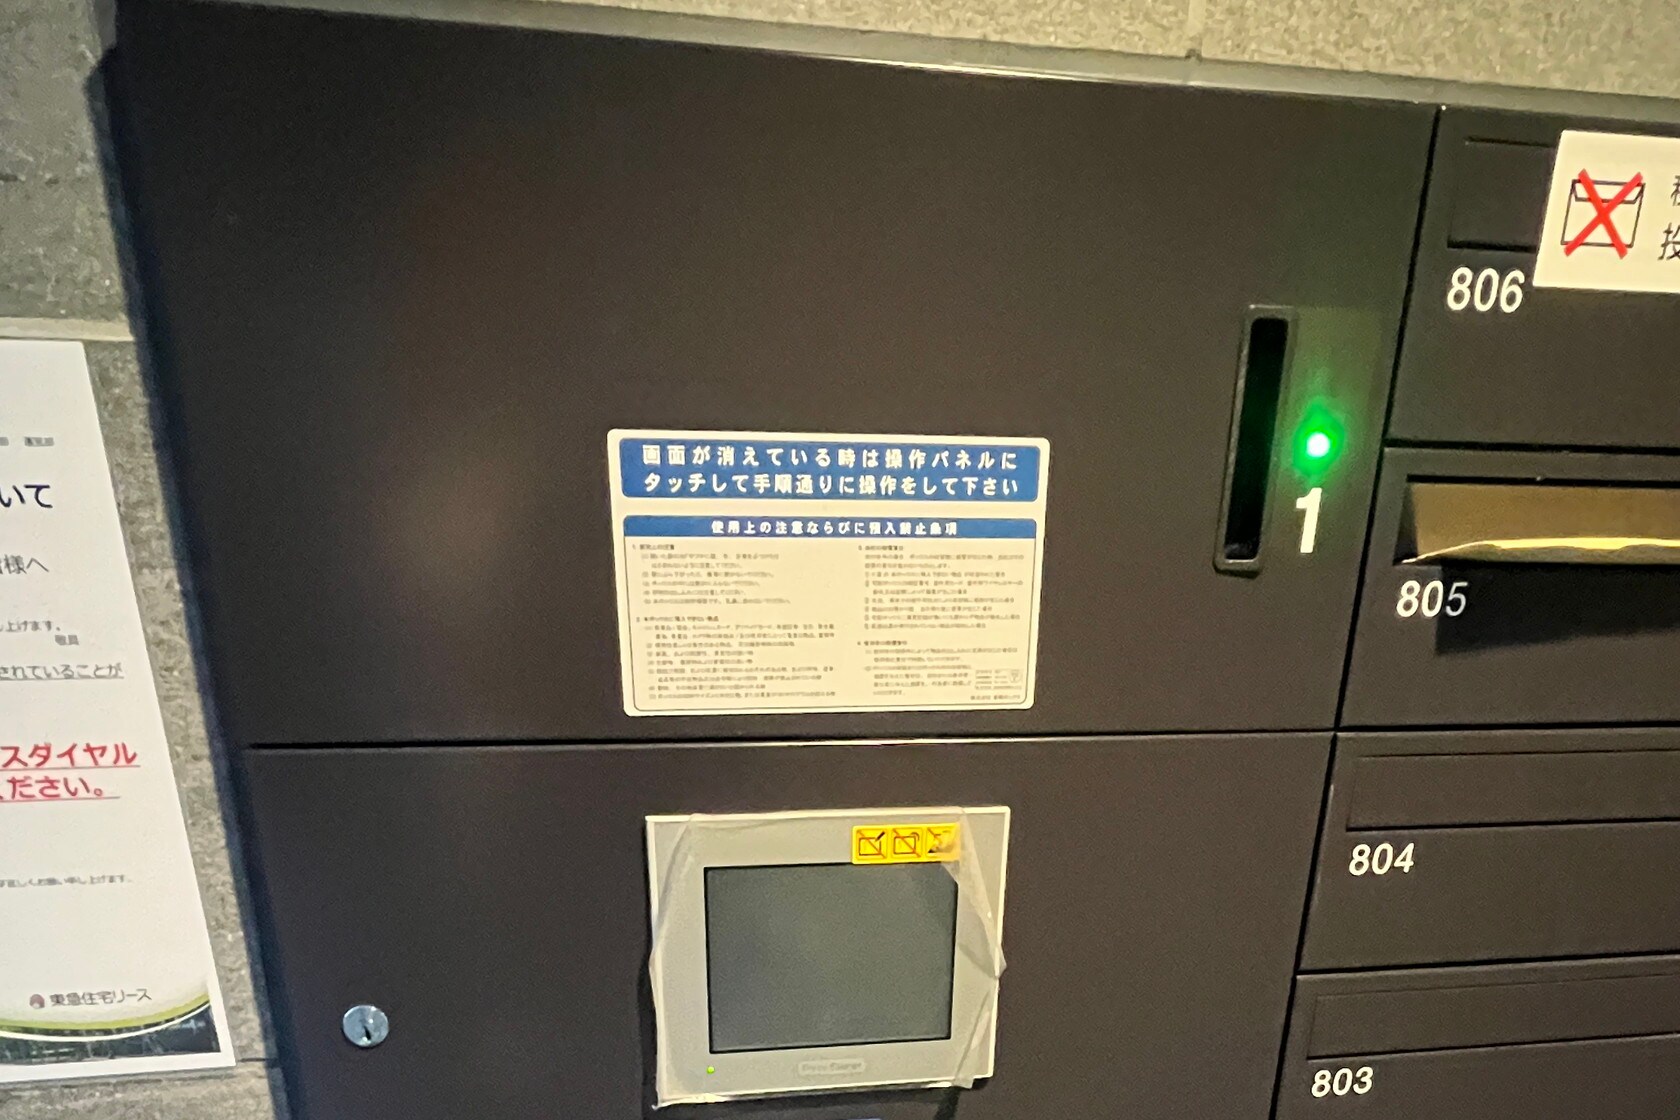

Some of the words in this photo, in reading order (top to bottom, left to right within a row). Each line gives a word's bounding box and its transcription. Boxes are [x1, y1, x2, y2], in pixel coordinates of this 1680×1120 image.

[1446, 266, 1524, 313] 806
[643, 444, 1017, 469] 画面が消えている時は操作パネルに
[644, 471, 1018, 494] タッチして手順通りに操作をして下さい
[1296, 488, 1322, 553] 1
[0, 554, 50, 575] 様へ
[1396, 580, 1468, 618] 805
[0, 620, 61, 633] 上げます。
[0, 742, 137, 768] スダイヤル
[0, 776, 103, 799] ださい。
[1349, 843, 1414, 875] 804
[1312, 1066, 1373, 1097] 803
